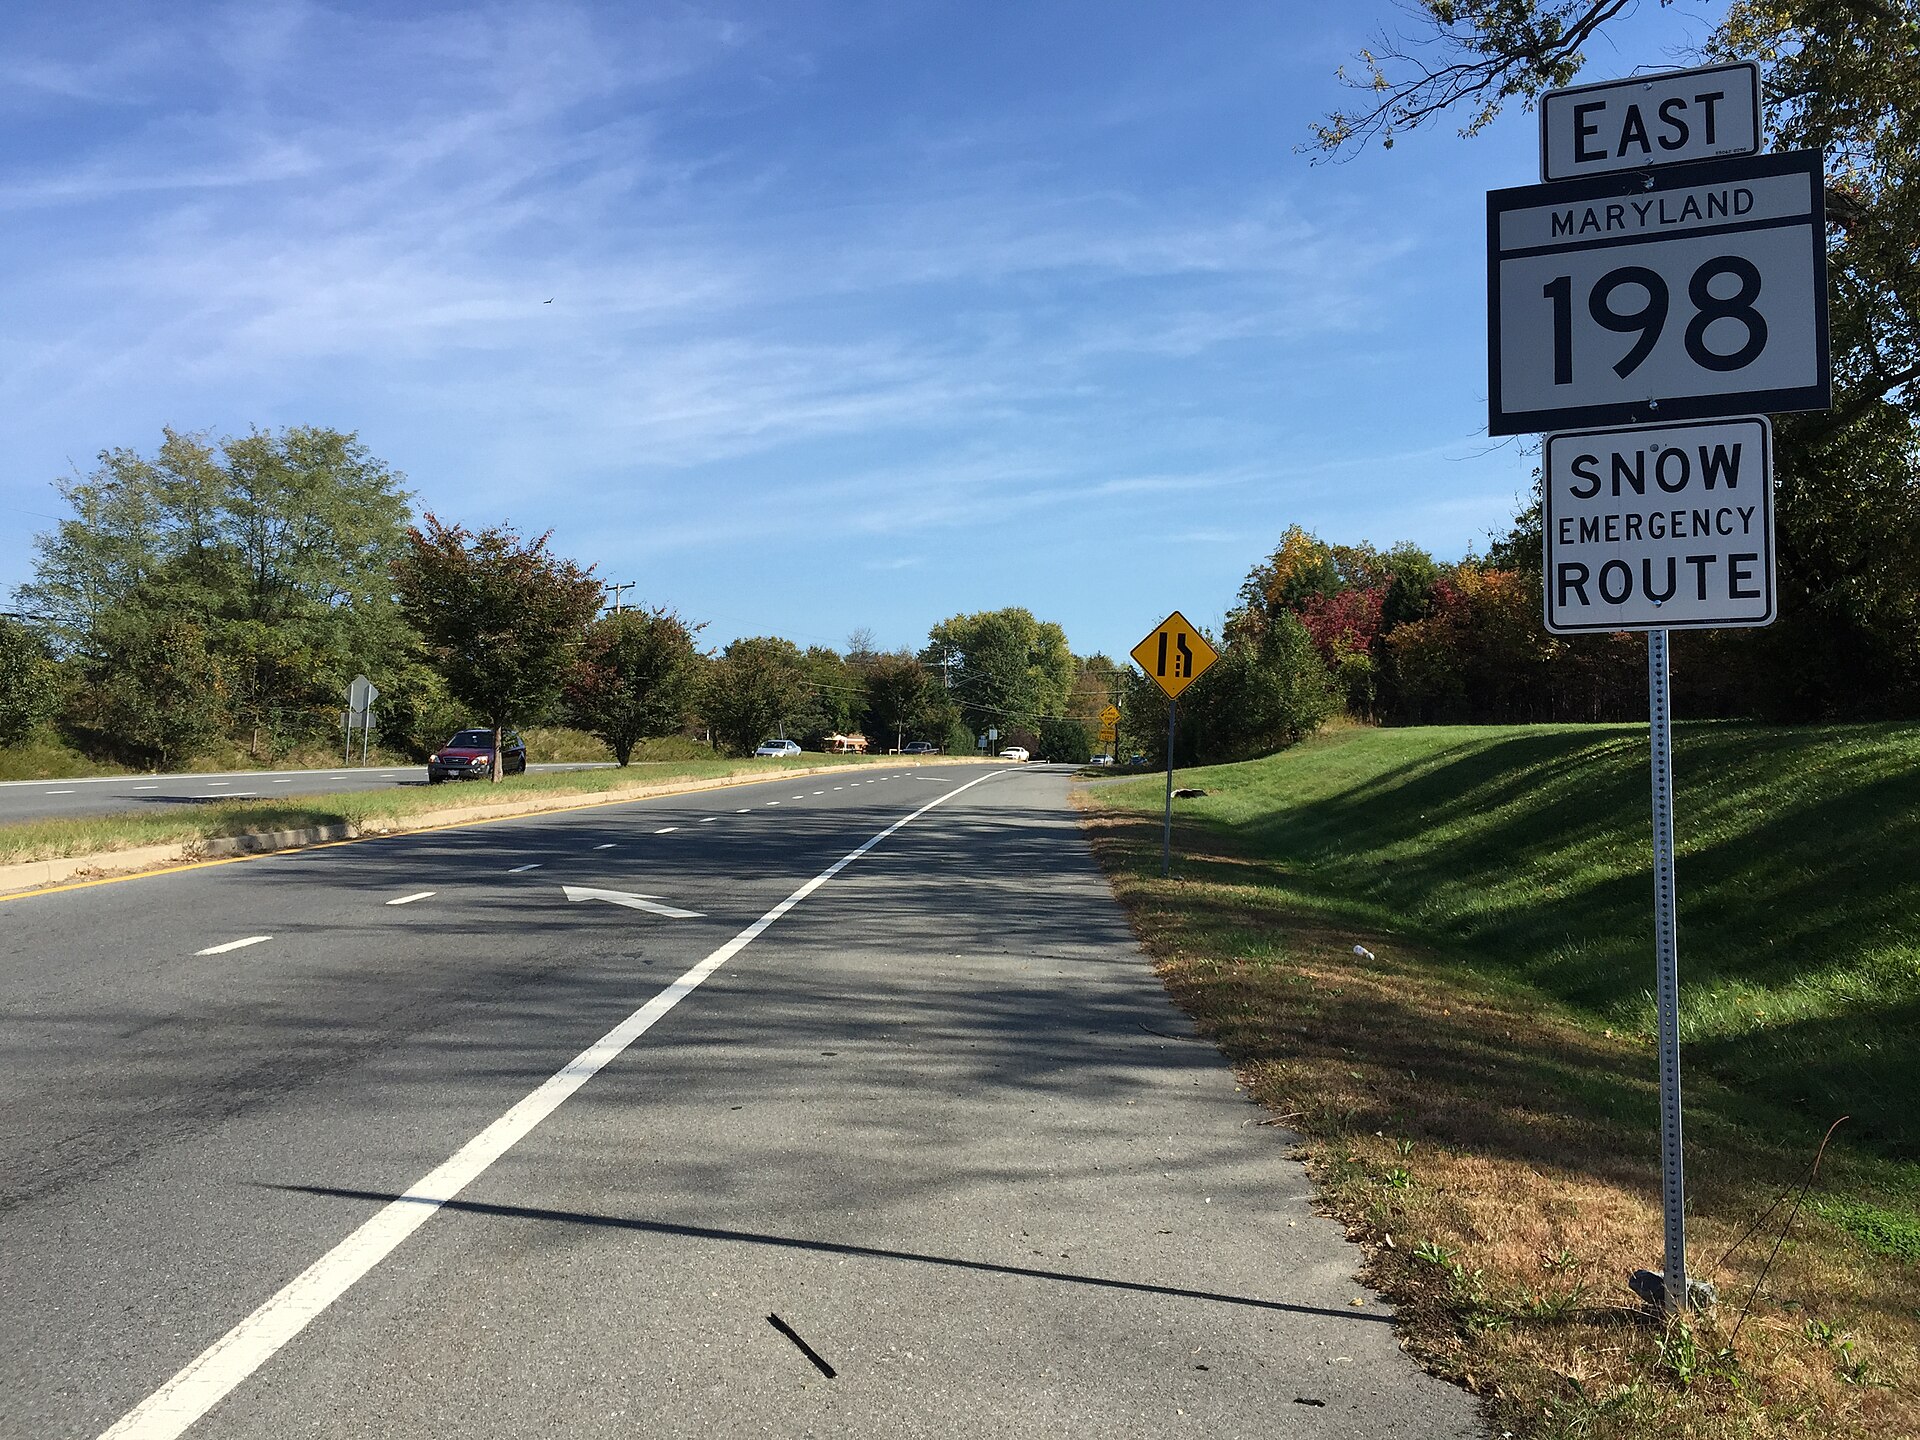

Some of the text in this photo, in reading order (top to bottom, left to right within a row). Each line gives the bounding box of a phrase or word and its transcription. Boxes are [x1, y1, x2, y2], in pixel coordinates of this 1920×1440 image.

[1574, 91, 1724, 163] EAST
[1552, 188, 1754, 237] MARYLAND
[1543, 256, 1768, 385] 198
[1570, 443, 1741, 499] SNOW
[1559, 506, 1755, 545] EMERGENCY
[1558, 553, 1760, 606] ROUTE
